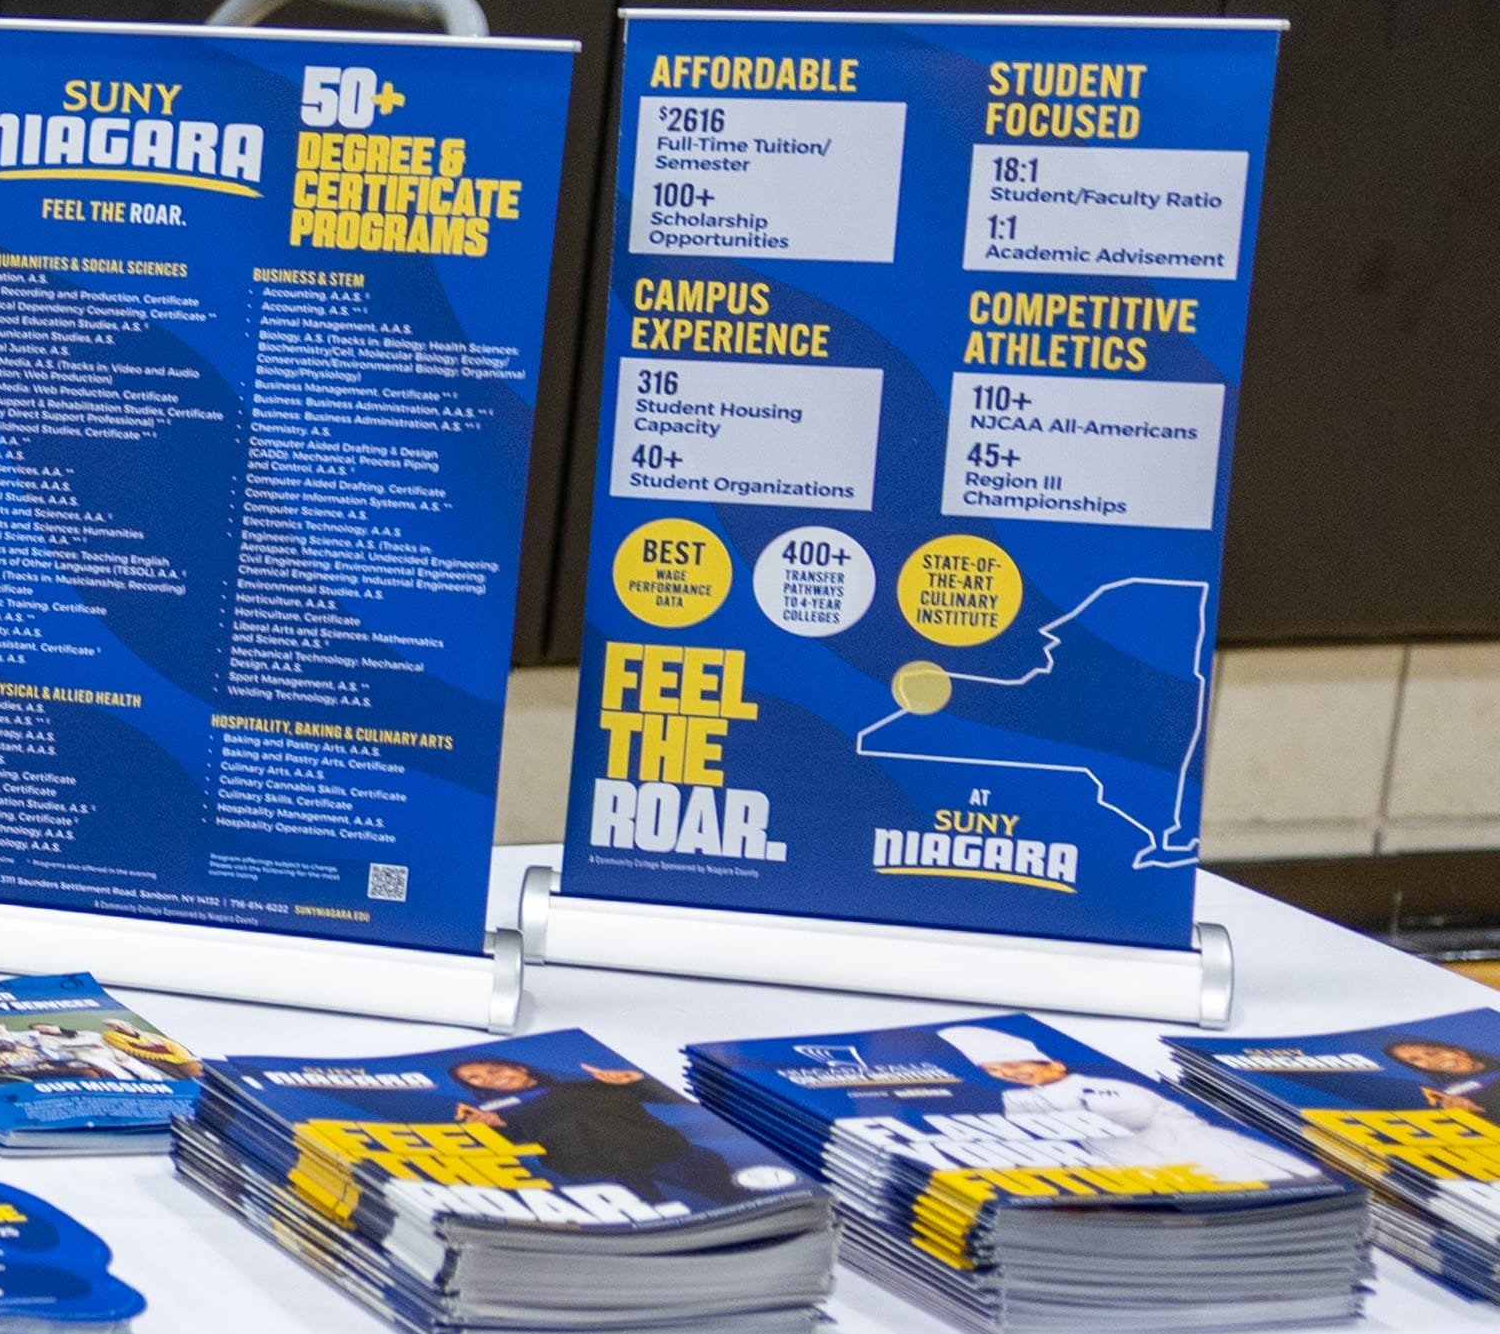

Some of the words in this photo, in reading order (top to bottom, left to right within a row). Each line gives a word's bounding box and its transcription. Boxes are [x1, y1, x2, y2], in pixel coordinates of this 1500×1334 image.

[649, 55, 858, 93] AFFORDABLE
[988, 61, 1147, 99] STUDENT
[62, 79, 182, 116] SUNY
[300, 65, 405, 129] 50+
[658, 104, 726, 134] $2616
[985, 102, 1141, 139] FOCUSED
[297, 131, 436, 176] DEGREE
[438, 137, 467, 178] &
[656, 136, 749, 156] Full-Time
[752, 137, 833, 158] Tuition/
[654, 155, 750, 174] Semester
[992, 156, 1040, 184] 18:1
[293, 171, 521, 220] CERTIFICATE
[652, 182, 716, 209] 100+
[989, 187, 1161, 210] Student/Faculty
[1166, 192, 1223, 209] Ratio
[42, 197, 87, 221] FEEL
[90, 200, 125, 223] THE
[129, 202, 187, 227] ROAR.
[650, 212, 768, 233] Scholarship
[289, 208, 489, 258] PROGRAMS
[648, 230, 790, 252] Opportunities
[987, 214, 1018, 241] 1:1
[70, 256, 79, 271] &
[81, 258, 124, 274] SOCIAL
[127, 260, 188, 278] SCIENCES
[984, 244, 1090, 264] Academic
[1095, 248, 1225, 269] Advisement
[253, 267, 316, 285] BUSINESS
[317, 271, 327, 286] &
[329, 271, 365, 288] STEM
[635, 278, 770, 315] CAMPUS
[969, 290, 1198, 334] COMPETITIVE
[631, 318, 830, 358] EXPERIENCE
[963, 331, 1147, 372] ATHLETICS
[636, 368, 678, 396] 316
[635, 400, 715, 418] Student
[719, 403, 803, 424] Housing
[972, 385, 1032, 413] 110+
[634, 417, 721, 439] Capacity
[970, 415, 1043, 434] NJCAA
[1047, 418, 1198, 441] All-Americans
[631, 443, 684, 471] 40+
[967, 442, 1021, 470] 45+
[629, 473, 709, 491] Student
[713, 476, 856, 499] Organizations
[964, 472, 1039, 493] Region
[1045, 474, 1062, 491] III
[963, 489, 1127, 515] Championships
[642, 539, 706, 566] BEST
[782, 540, 851, 566] 400+
[923, 554, 1002, 573] STATE-OF-
[656, 568, 686, 581] WAGE
[785, 569, 845, 584] TRANSFER
[929, 572, 993, 591] THE-ART
[629, 581, 712, 596] PERFORMANCE
[656, 595, 683, 607] DATA
[783, 582, 845, 597] PATHWAYS
[921, 590, 998, 609] CULINARY
[783, 609, 840, 624] COLLEGES
[784, 596, 798, 608] TO
[800, 597, 841, 610] 4-YEAR
[917, 608, 999, 628] INSTITUTE
[604, 641, 758, 721] FEEL
[42, 687, 51, 699] &
[52, 687, 93, 703] ALLIED
[95, 691, 141, 708] HEALTH
[211, 714, 293, 736] HOSPITALITY,
[295, 721, 341, 739] BAKING
[344, 725, 352, 739] &
[355, 726, 417, 747] CULINARY
[419, 734, 453, 750] ARTS
[599, 709, 729, 788] THE
[22, 771, 77, 785] Certificate
[219, 774, 263, 789] Culinary
[265, 780, 316, 794] Cannabis
[350, 787, 407, 802] Certificate
[970, 787, 989, 807] AT
[590, 777, 787, 861] ROAR.
[933, 809, 1020, 836] SUNY
[873, 828, 1078, 883] NIAGARA
[1212, 1053, 1384, 1070] NIAGARA
[33, 1081, 81, 1094] OUR
[80, 1080, 174, 1095] MISSION
[263, 1071, 435, 1088] NIAGARA
[308, 1119, 548, 1156] FEEL
[832, 1110, 1134, 1143] FLAVOR
[346, 1150, 554, 1190] THE
[385, 1177, 691, 1226] ROAR.
